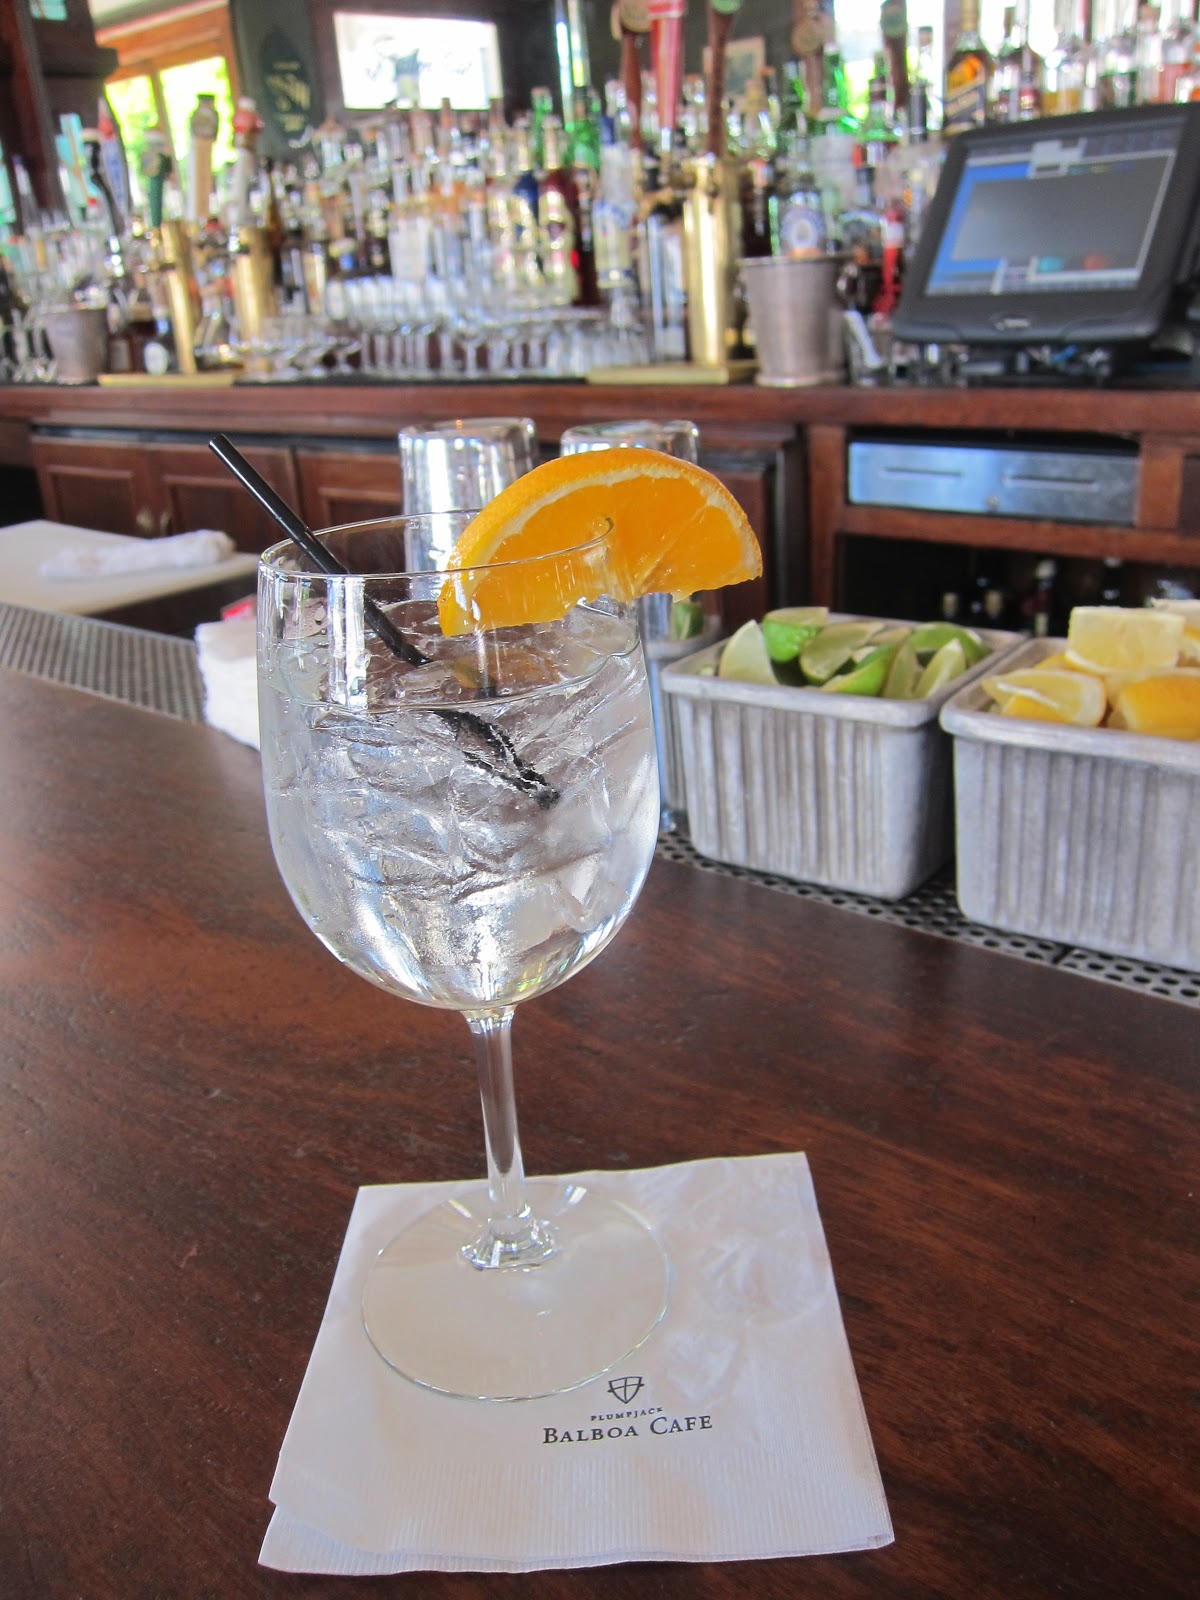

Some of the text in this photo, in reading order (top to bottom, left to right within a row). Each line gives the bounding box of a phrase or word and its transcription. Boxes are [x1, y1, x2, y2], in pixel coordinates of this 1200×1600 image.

[591, 1407, 663, 1421] PLUMPJACK
[542, 1415, 713, 1444] BALBOA CAFE
